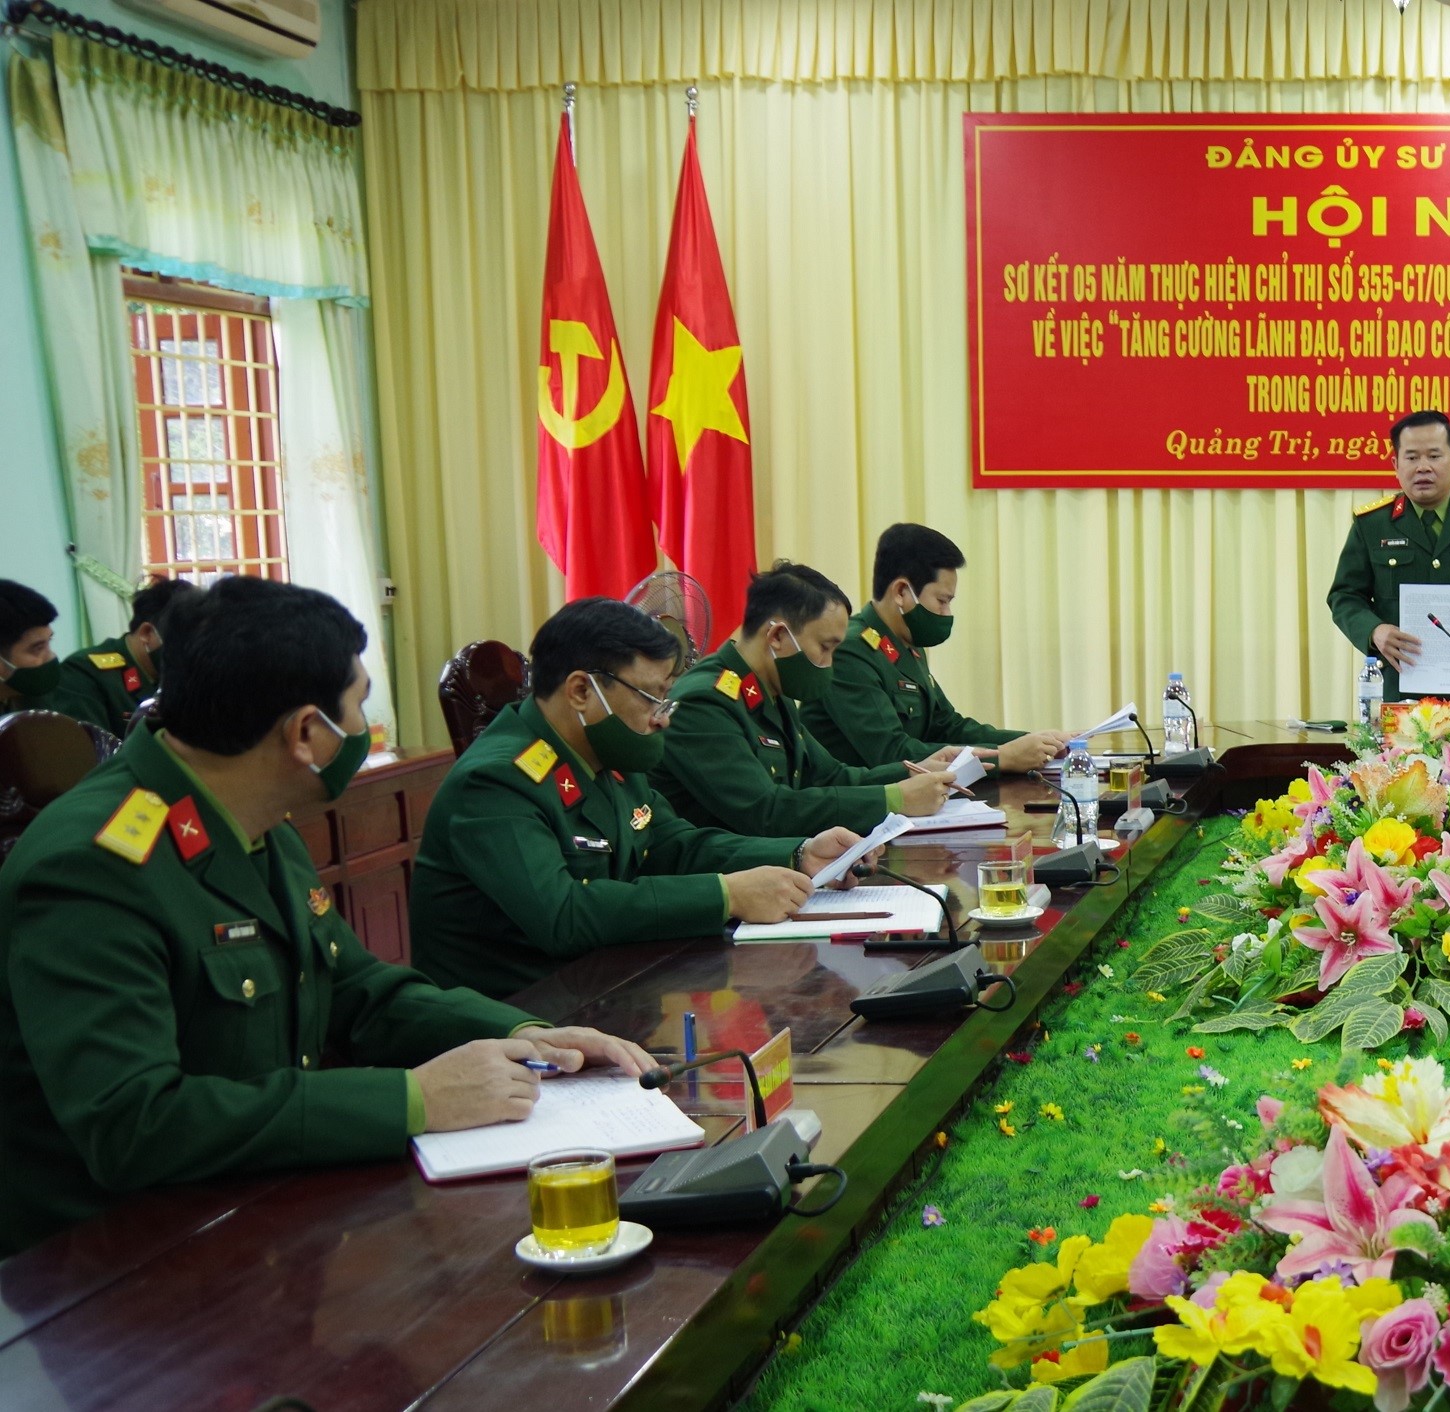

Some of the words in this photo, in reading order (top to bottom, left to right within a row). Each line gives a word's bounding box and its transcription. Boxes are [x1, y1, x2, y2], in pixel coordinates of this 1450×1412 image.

[1205, 137, 1325, 169] ĐẢNG
[1336, 137, 1386, 170] ỦY
[1396, 143, 1447, 170] SƯ
[1252, 184, 1388, 249] HỘI
[1003, 262, 1031, 303] SƠ
[1033, 254, 1070, 302] KẾT
[1072, 263, 1098, 303] 05
[1100, 256, 1146, 302] NĂM
[1149, 260, 1200, 310] THỰC
[1204, 255, 1251, 310] HIỆN
[1255, 251, 1289, 303] CHỈ
[1292, 263, 1323, 311] THỊ
[1327, 251, 1355, 303] SỐ
[1032, 308, 1057, 358] VỀ
[1059, 312, 1104, 366] VIỆC
[1174, 310, 1241, 358] CƯỜNG
[1245, 312, 1296, 358] LÃNH
[1299, 319, 1345, 366] ĐẠO,
[1349, 307, 1384, 358] CHỈ
[1385, 319, 1427, 367] ĐẠO
[1246, 374, 1311, 414] TRONG
[1314, 367, 1368, 417] QUÂN
[1371, 367, 1406, 421] ĐỘI
[1409, 374, 1450, 414] GIAI
[1165, 427, 1262, 460] Quảng
[1269, 430, 1320, 461] Trị,
[1328, 431, 1394, 460] ngày
